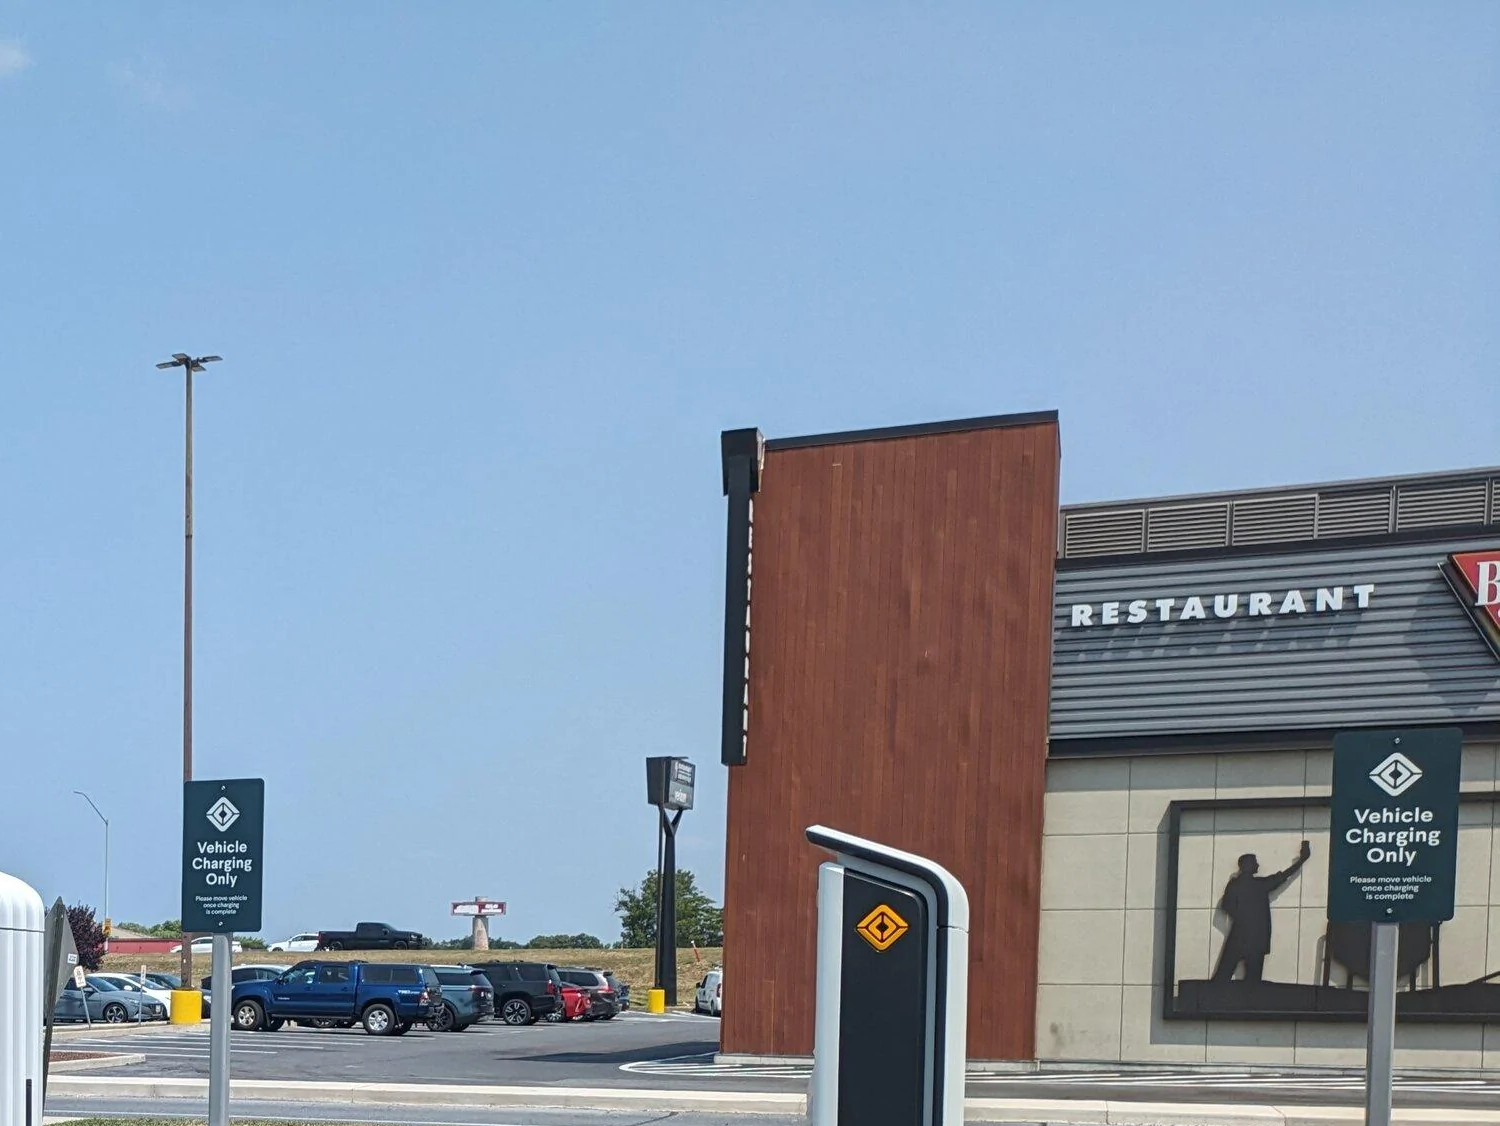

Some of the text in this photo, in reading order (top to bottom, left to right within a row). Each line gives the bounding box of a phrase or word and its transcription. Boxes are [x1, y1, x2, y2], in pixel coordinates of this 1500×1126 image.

[1071, 584, 1375, 627] RESTAURANT
[1353, 807, 1433, 824] Vehicle
[1345, 826, 1441, 847] Charging
[197, 841, 247, 854] Vehicle
[192, 857, 252, 872] Charging
[1366, 847, 1417, 867] Only
[205, 872, 238, 888] Only
[1349, 876, 1377, 884] Please
[1402, 875, 1432, 883] vehicle
[1384, 884, 1419, 893] charging
[1374, 893, 1414, 901] complete
